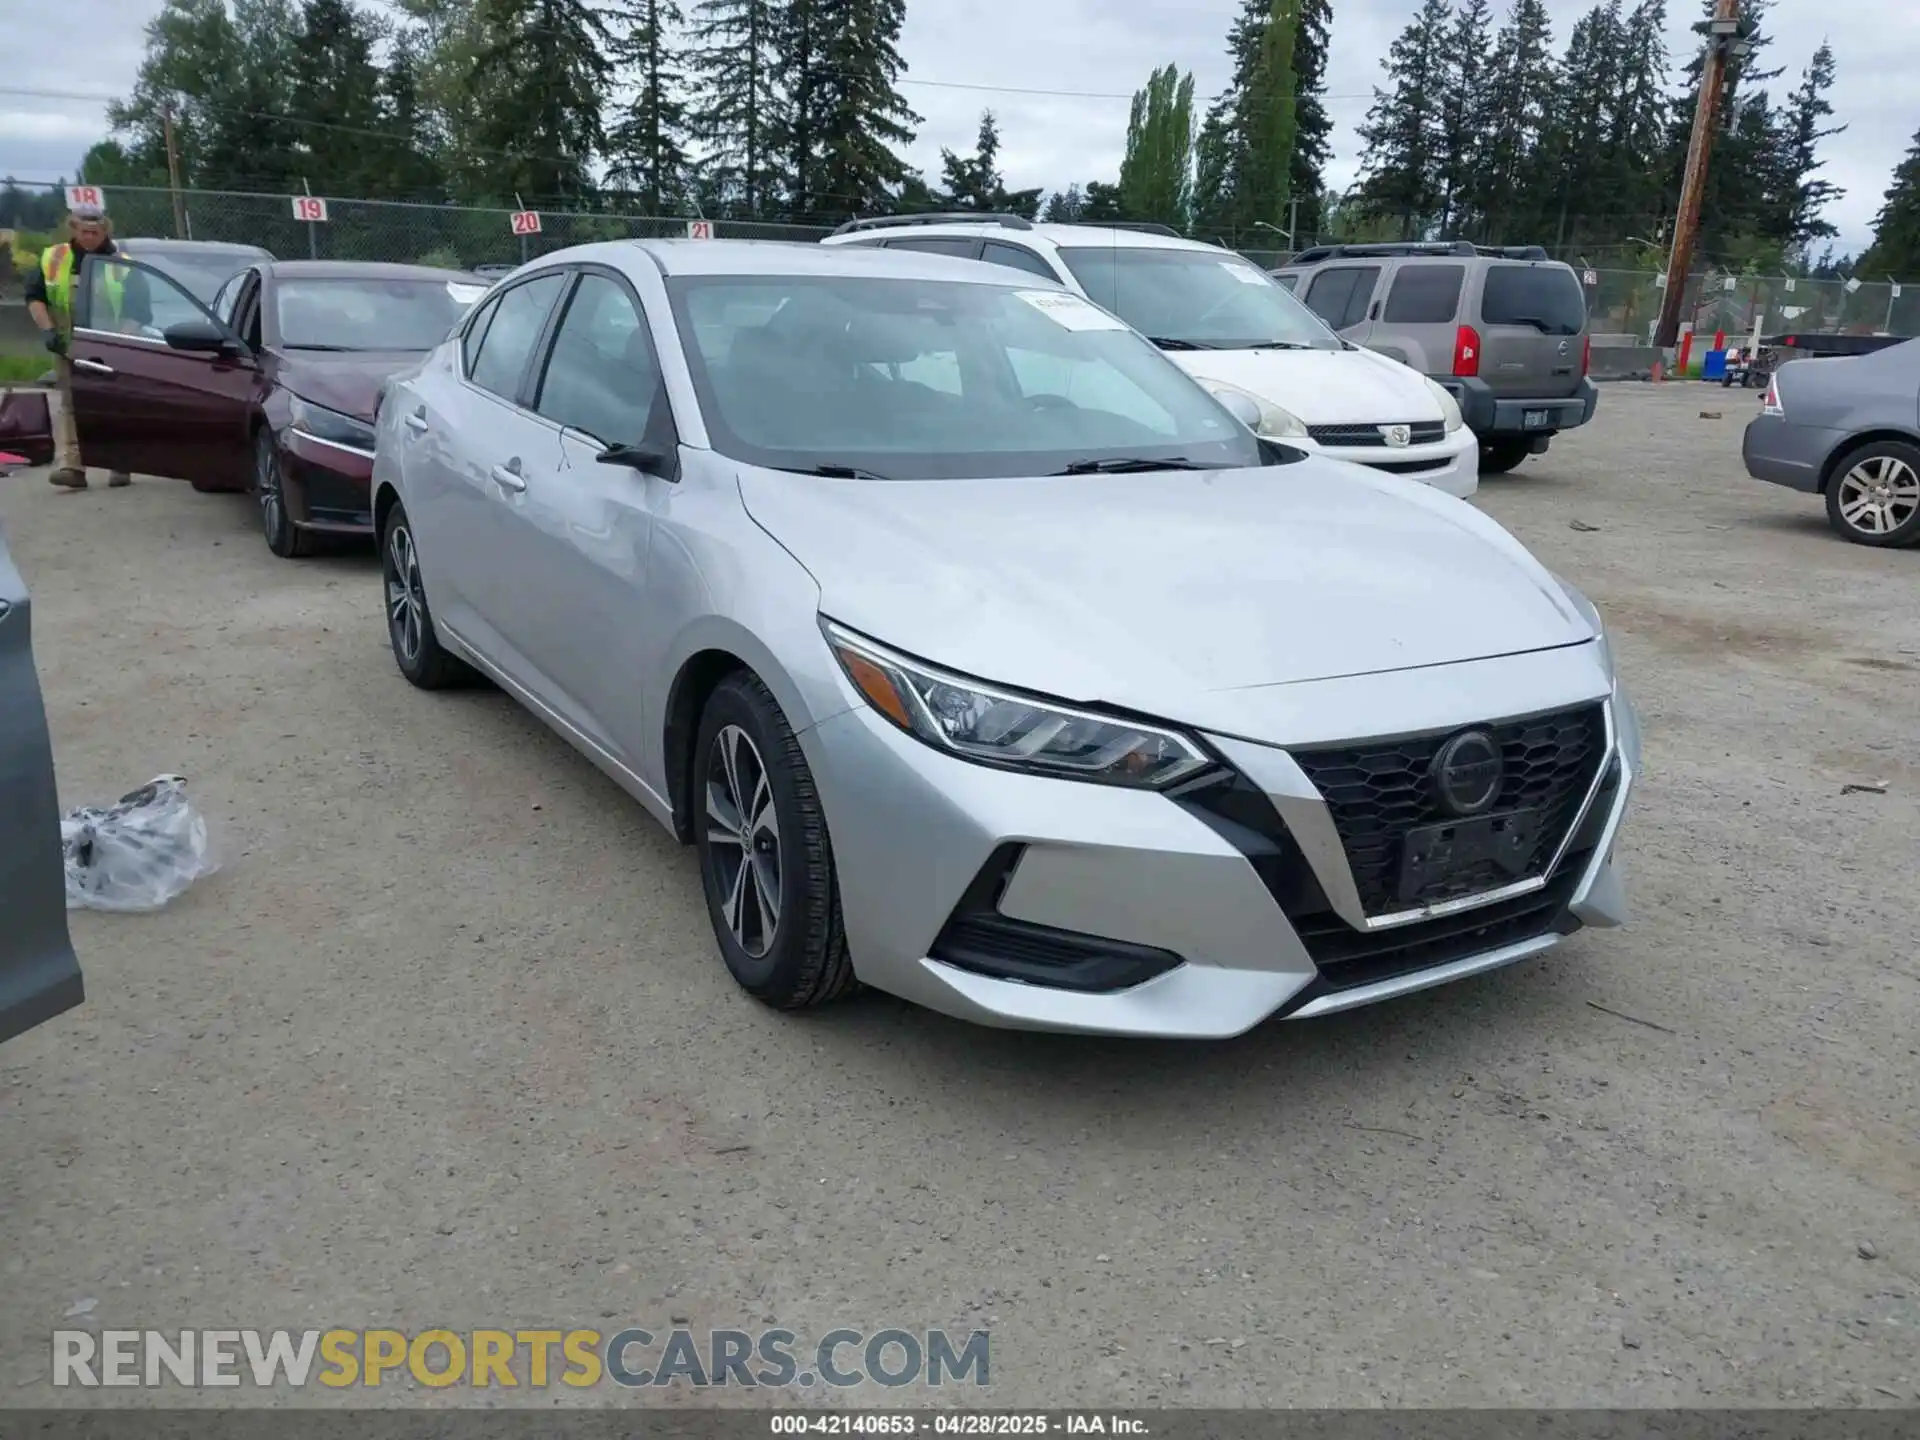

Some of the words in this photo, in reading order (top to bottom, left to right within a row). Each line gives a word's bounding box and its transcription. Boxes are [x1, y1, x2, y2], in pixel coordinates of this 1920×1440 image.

[298, 199, 321, 219] 19
[514, 211, 538, 232] 20
[692, 222, 708, 239] 21
